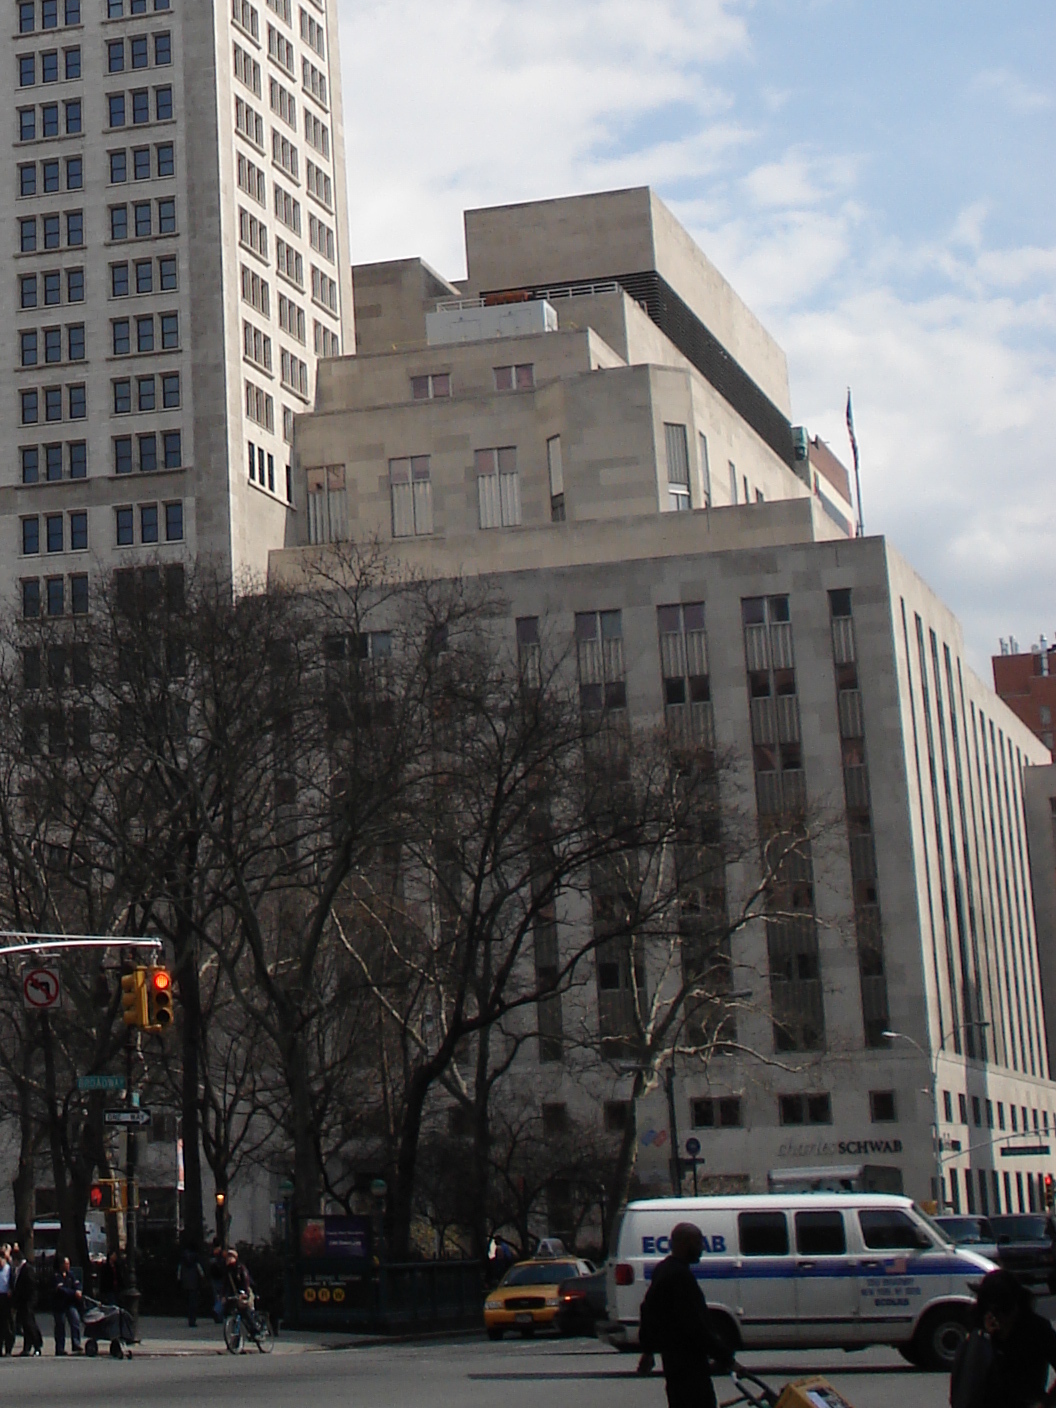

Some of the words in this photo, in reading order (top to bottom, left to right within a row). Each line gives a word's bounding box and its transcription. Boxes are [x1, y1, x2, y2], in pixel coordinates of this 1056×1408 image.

[78, 1076, 125, 1089] BROADWAY
[777, 1136, 836, 1157] charles
[838, 1139, 903, 1154] SCHWAB
[642, 1235, 727, 1253] ECAB
